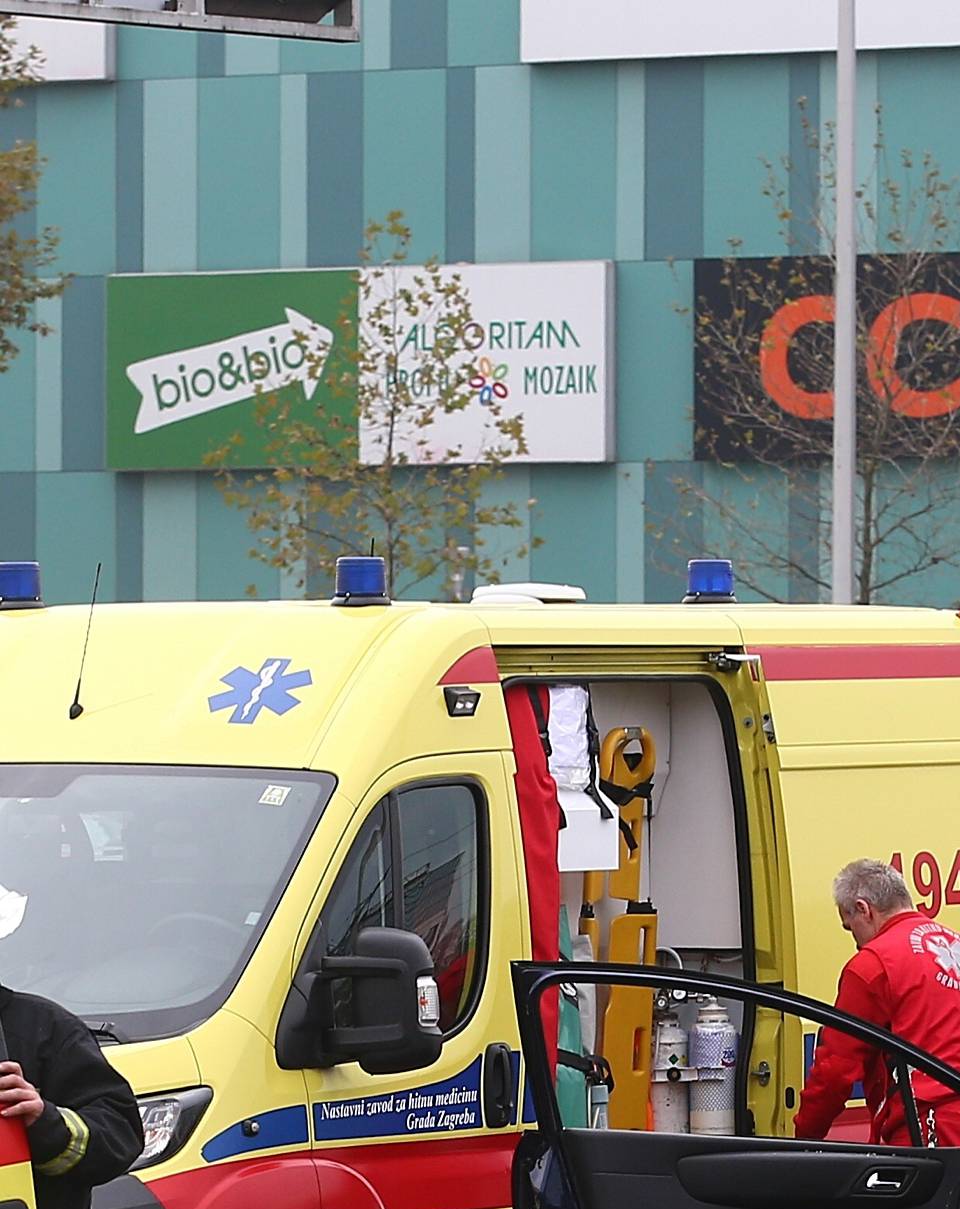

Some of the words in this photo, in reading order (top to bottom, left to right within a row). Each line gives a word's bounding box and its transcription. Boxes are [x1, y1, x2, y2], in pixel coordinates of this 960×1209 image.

[152, 335, 307, 411] bio&bio
[523, 365, 597, 395] MOZAIK
[321, 1099, 365, 1120] Nastavni
[366, 1095, 393, 1116] zavod
[395, 1098, 406, 1112] za
[408, 1092, 433, 1110] hitnu
[435, 1086, 477, 1106] medicinu
[406, 1113, 435, 1130] Grada
[437, 1107, 475, 1130] Zagreba
